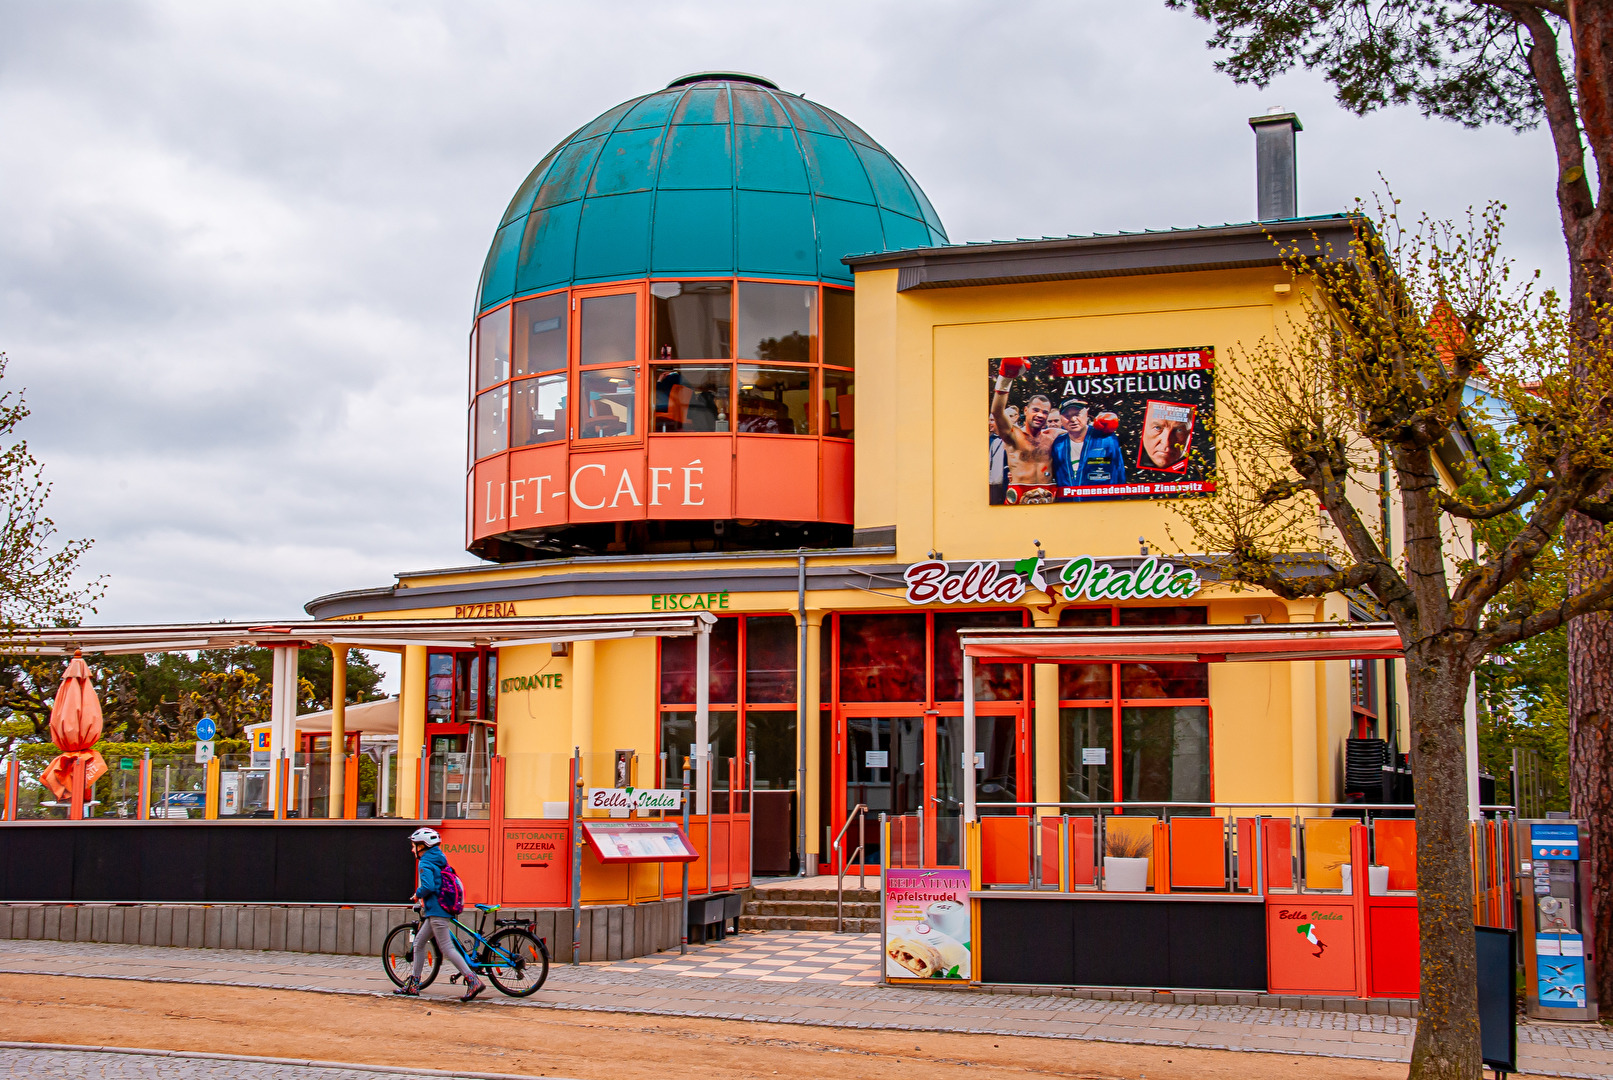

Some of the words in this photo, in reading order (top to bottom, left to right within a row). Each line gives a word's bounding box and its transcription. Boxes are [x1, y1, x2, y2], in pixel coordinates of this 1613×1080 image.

[1062, 358, 1107, 375] ULLI
[1116, 352, 1202, 372] WEGNER
[1062, 373, 1202, 396] AUSSTELLUNG
[485, 458, 705, 524] LIFT-CAFÉ
[1063, 485, 1150, 496] Promenadenhalle
[904, 561, 1024, 602] Bella
[1062, 556, 1199, 600] Italia
[651, 589, 730, 610] EISCAFÉ
[455, 602, 517, 619] PIZZERIA
[501, 673, 563, 693] ISTORANTE
[593, 791, 627, 807] Bella
[638, 791, 675, 807] Italia
[506, 832, 565, 841] RISTORANTE
[441, 844, 485, 854] IRAMISU
[516, 842, 555, 850] PIZZERIA
[517, 852, 554, 861] EISCAFÉ
[889, 878, 926, 889] BELLA
[929, 878, 967, 889] ITALIA
[889, 891, 957, 903] Apfelstrudel
[1279, 909, 1307, 920] Bella
[1311, 910, 1343, 921] Italia
